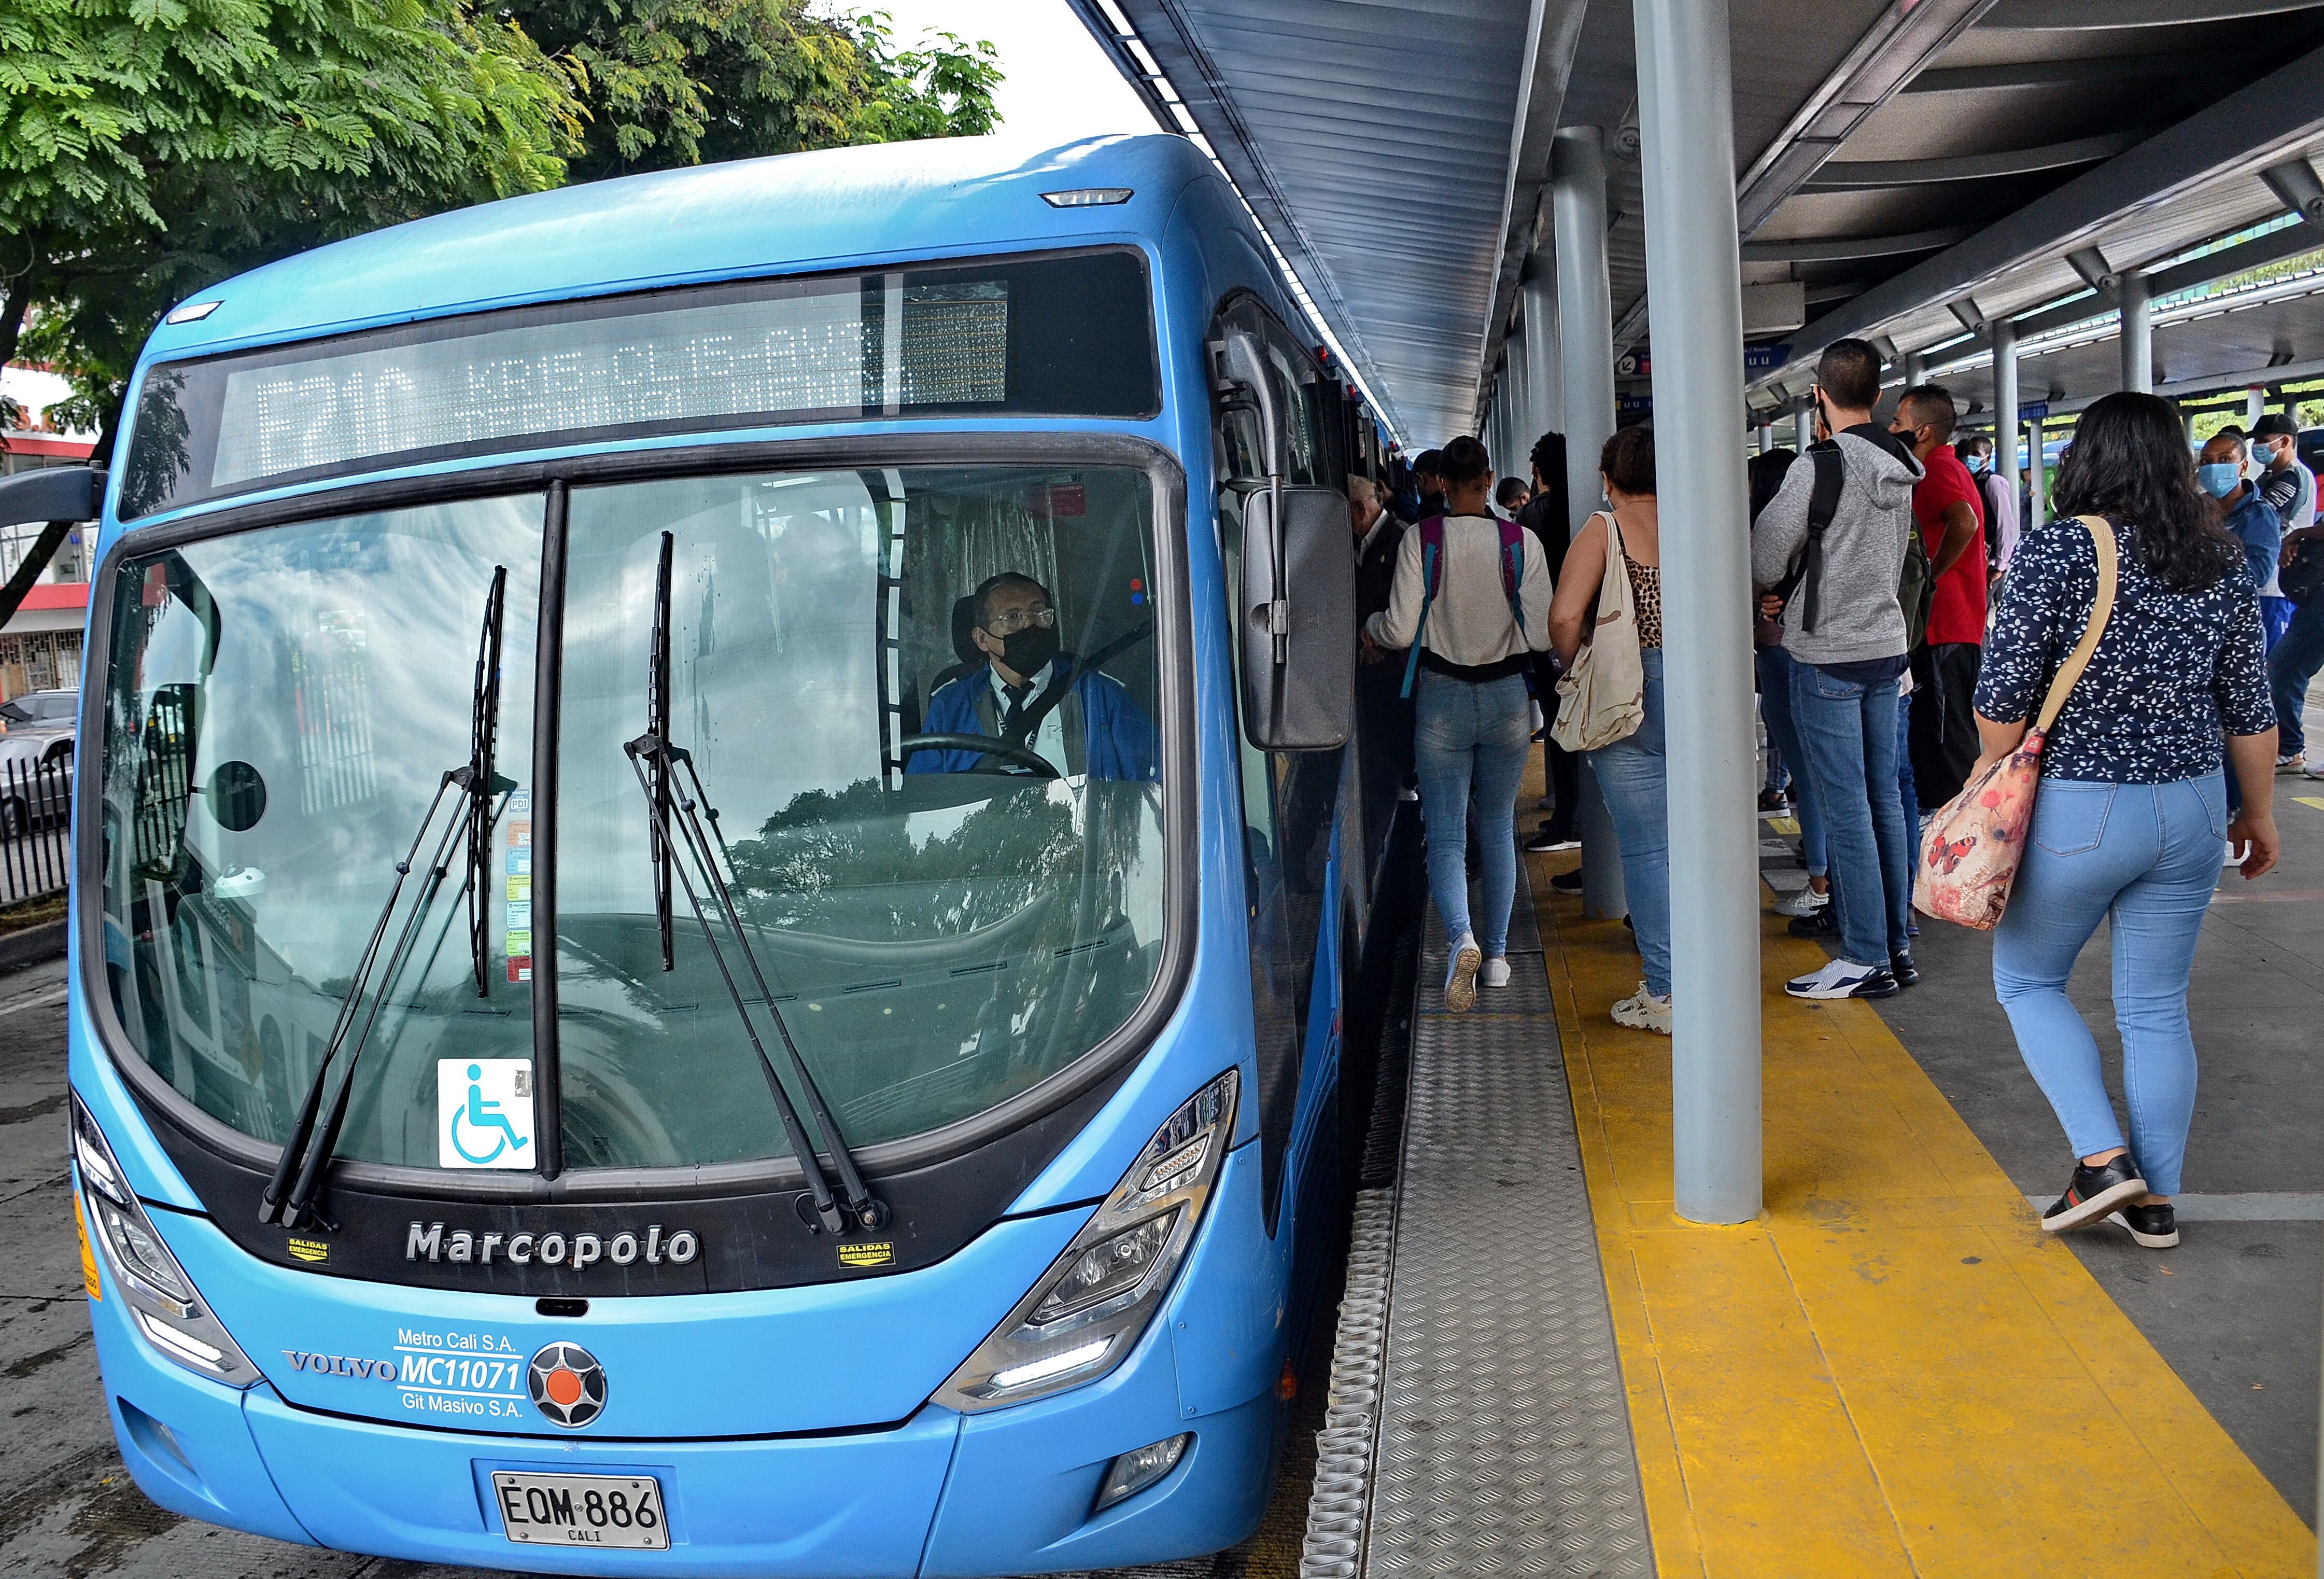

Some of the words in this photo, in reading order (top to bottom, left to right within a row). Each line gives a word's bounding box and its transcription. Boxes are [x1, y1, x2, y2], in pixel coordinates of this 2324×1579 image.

[512, 800, 527, 808] PDI
[289, 1239, 328, 1250] SALIDAS
[406, 1221, 700, 1271] Marcopolo
[839, 1243, 891, 1253] SALIDAS
[289, 1246, 328, 1257] EMERGENCIA
[840, 1251, 892, 1261] EMERGENCIA
[398, 1328, 443, 1347] Metro
[446, 1332, 477, 1350] Cali
[482, 1334, 517, 1352] S.A.
[281, 1350, 398, 1382] VOLVO
[400, 1355, 519, 1390] MC11071
[402, 1392, 425, 1411] Git
[428, 1395, 485, 1416] Masivo
[488, 1399, 523, 1418] S.A.
[568, 1529, 601, 1542] CALI
